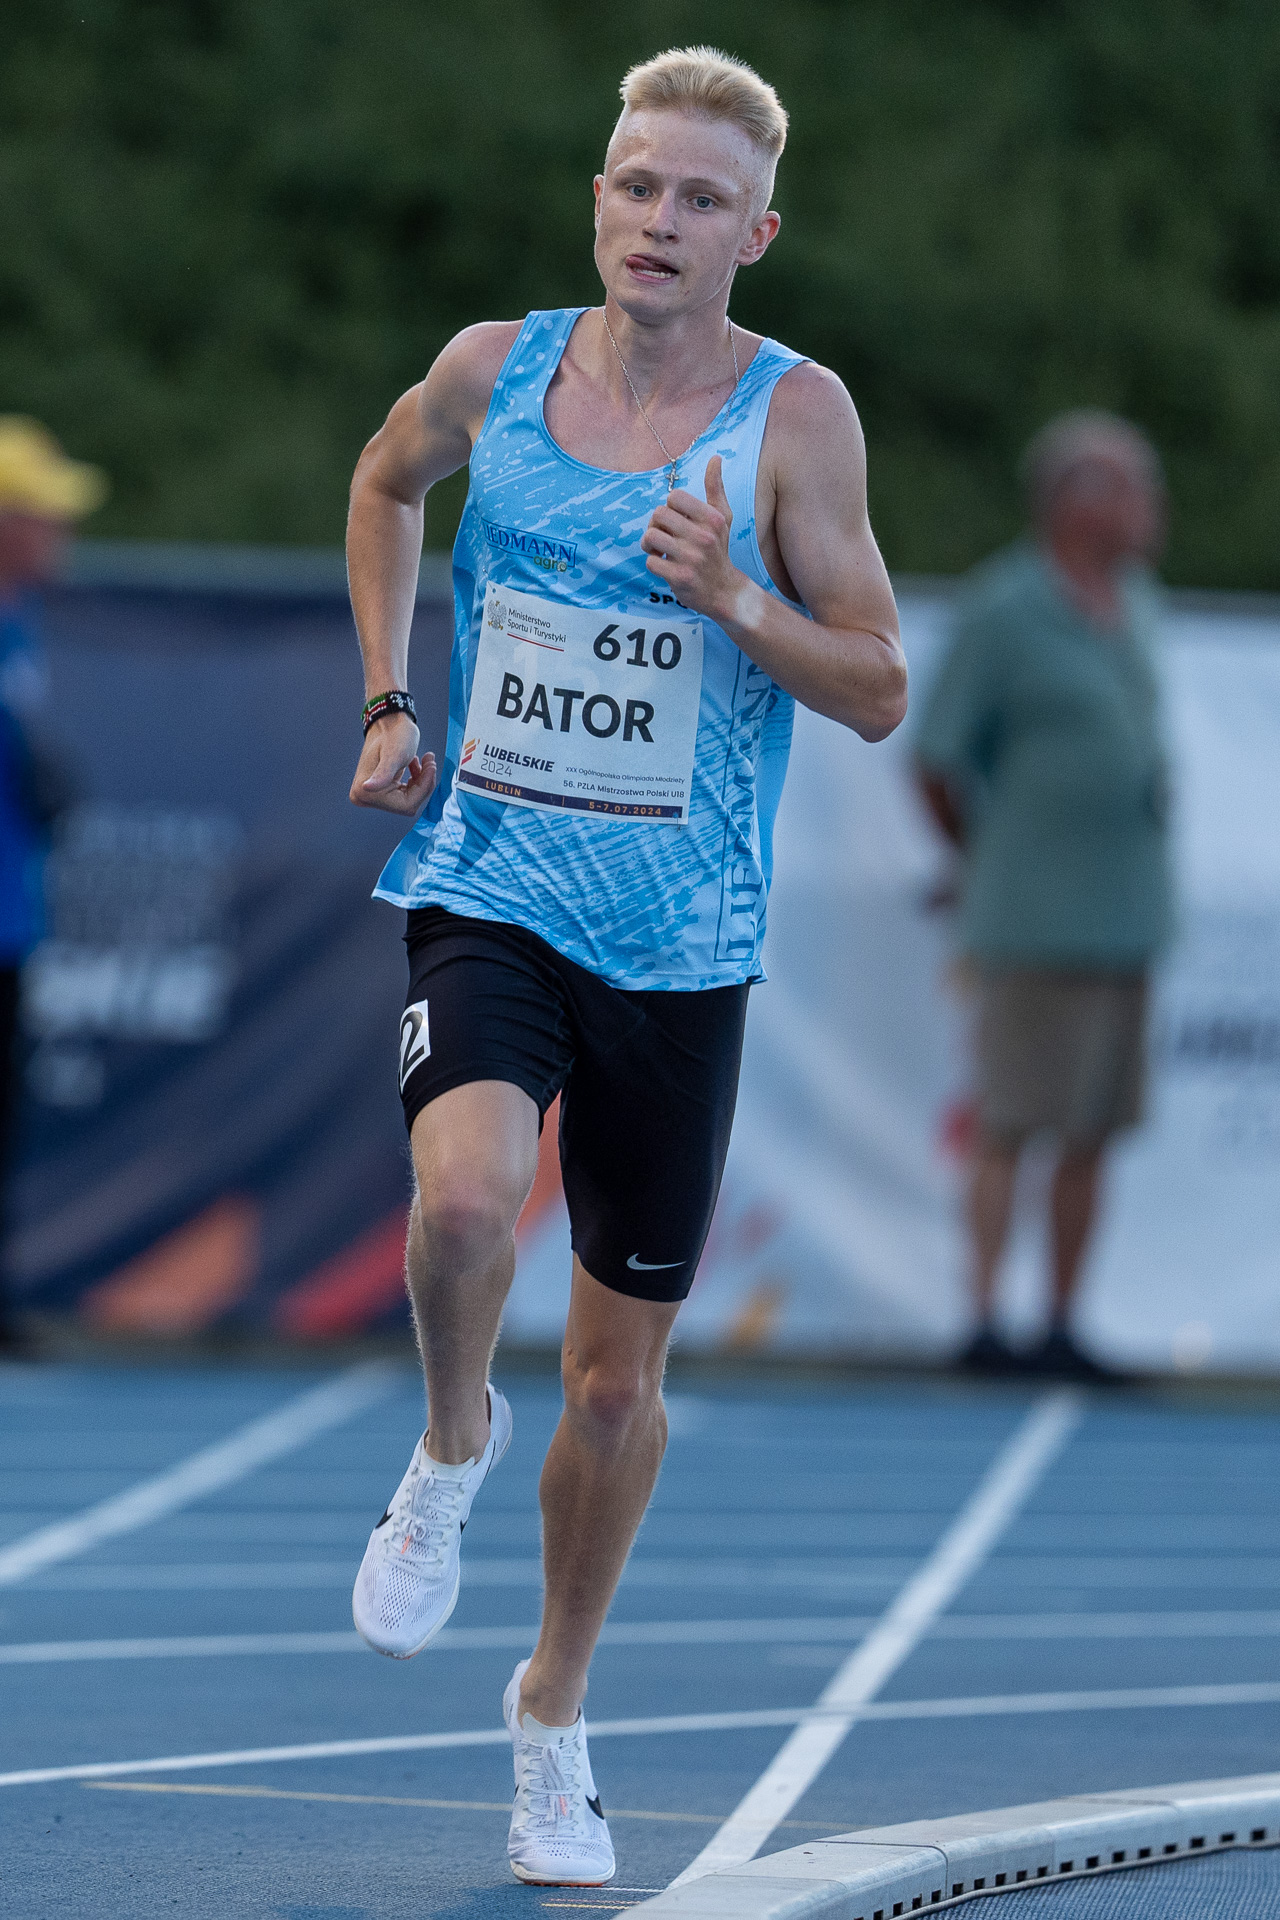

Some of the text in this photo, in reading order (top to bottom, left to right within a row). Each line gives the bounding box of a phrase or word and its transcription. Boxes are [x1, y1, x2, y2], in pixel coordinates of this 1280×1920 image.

[533, 555, 568, 573] agro
[508, 607, 551, 629] Ministerstwo
[507, 618, 567, 643] Sportu i Turystyki
[593, 623, 682, 670] 610
[496, 671, 655, 743] BATOR
[480, 758, 513, 777] 2024
[483, 743, 555, 773] LUBELSKIE
[565, 766, 578, 774] XXX
[578, 767, 621, 780] Ogólnopolska
[621, 774, 655, 782] Olimpiada
[485, 780, 522, 797] LUBLIN
[563, 779, 576, 789] 56.
[577, 781, 596, 791] PZLA
[597, 785, 645, 796] Mistrzostwa
[646, 789, 670, 798] Polski
[588, 801, 662, 815] 5-7.07.2024
[400, 1010, 425, 1085] 2
